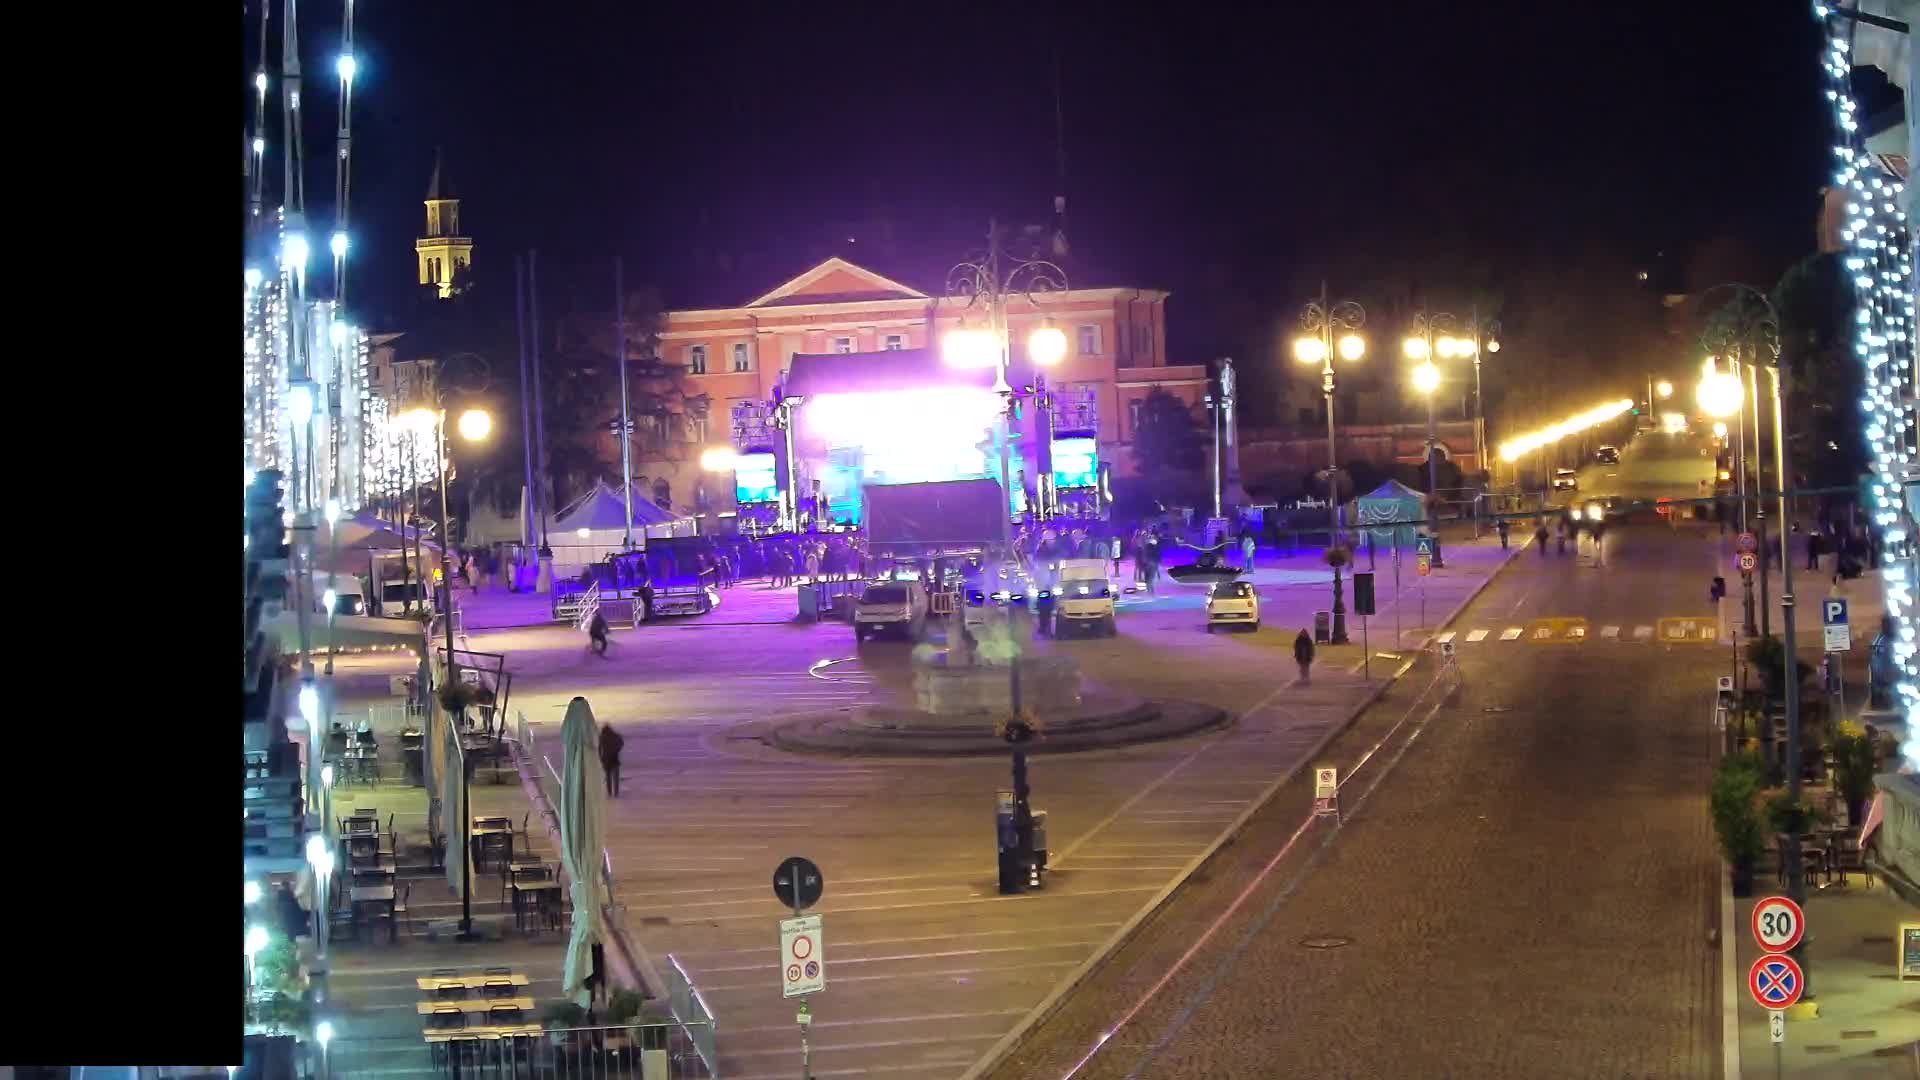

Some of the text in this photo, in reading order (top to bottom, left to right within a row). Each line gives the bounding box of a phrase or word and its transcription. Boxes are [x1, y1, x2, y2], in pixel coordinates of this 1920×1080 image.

[1743, 558, 1753, 567] 20
[1827, 603, 1842, 622] P
[1763, 912, 1791, 937] 30
